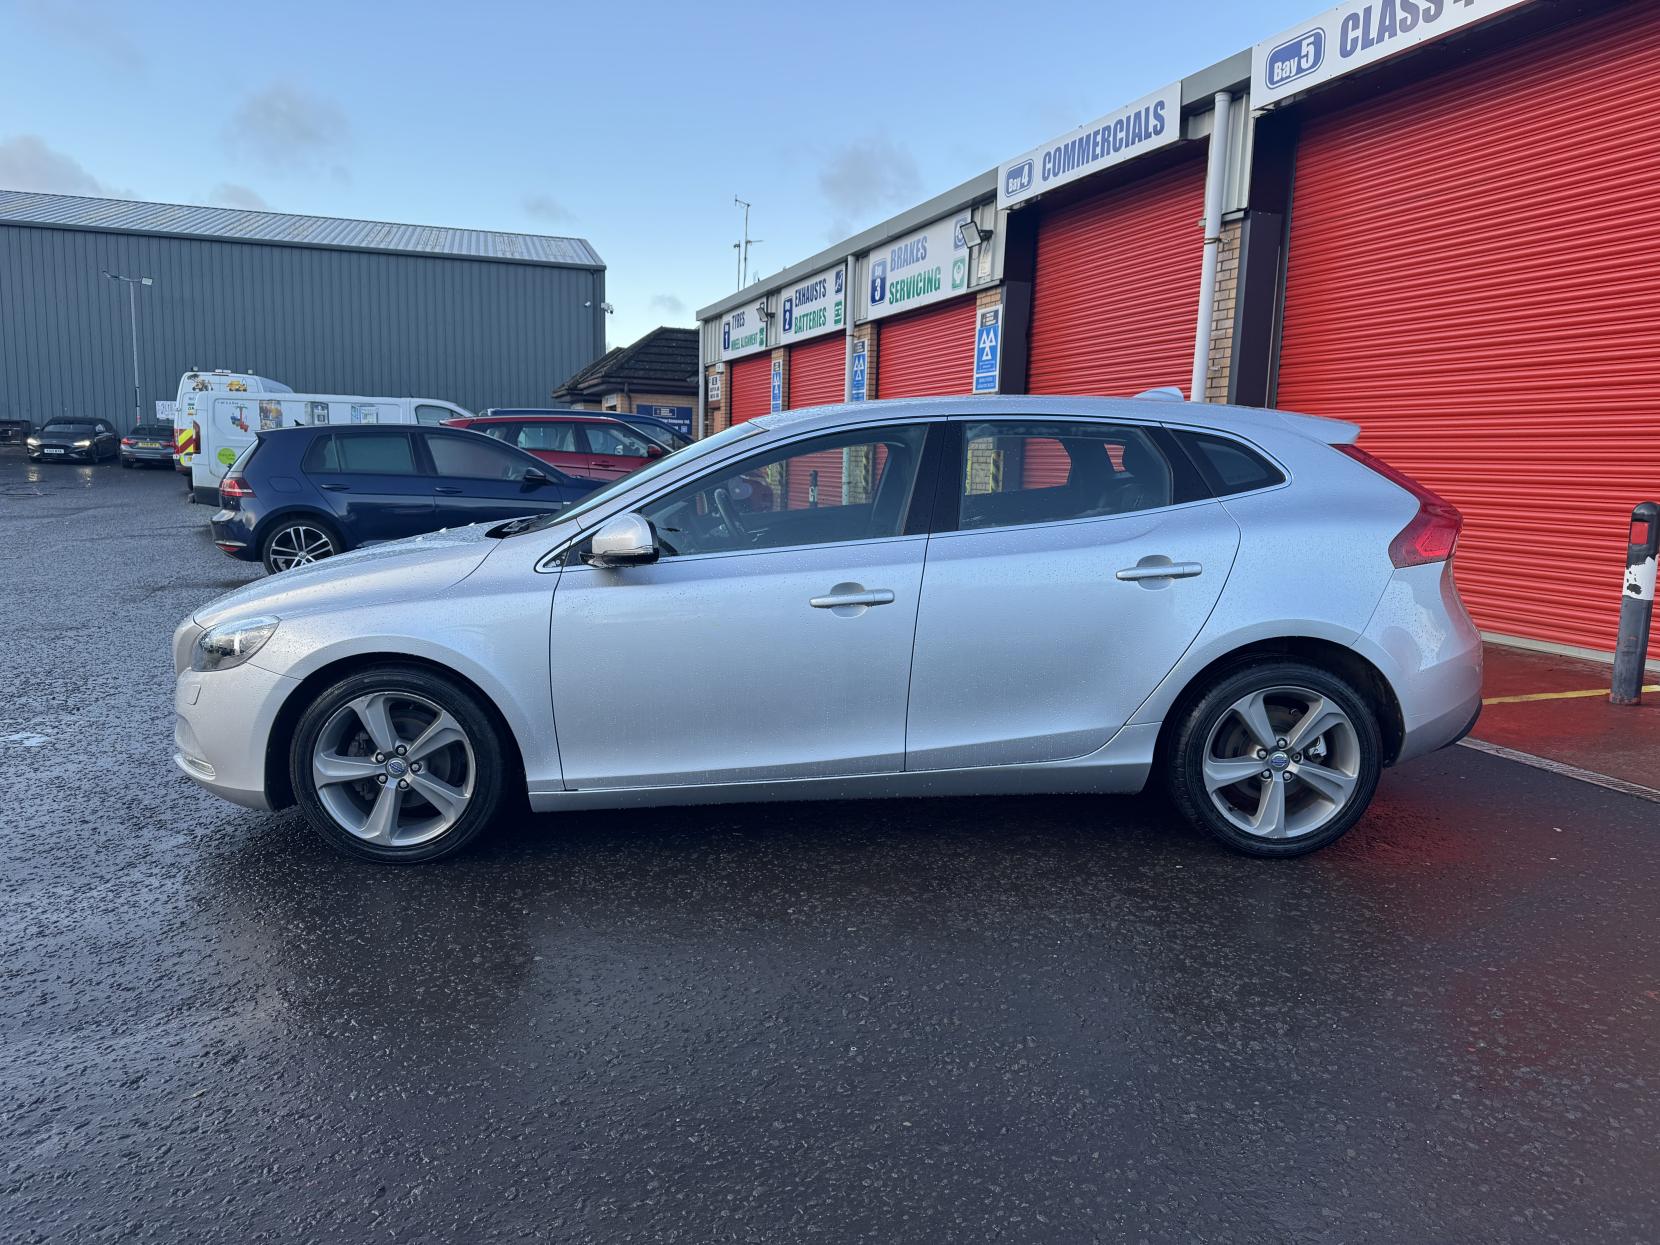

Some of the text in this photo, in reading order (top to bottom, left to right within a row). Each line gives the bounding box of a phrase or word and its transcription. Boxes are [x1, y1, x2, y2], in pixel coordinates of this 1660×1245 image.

[1273, 36, 1315, 82] Bay 5
[1041, 100, 1165, 182] COMMERCIALS
[1008, 164, 1029, 191] Bay 4
[890, 235, 928, 272] BRAKES
[795, 277, 827, 308] EXHAUSTS
[874, 278, 881, 301] 3
[889, 266, 941, 305] SERVICING
[732, 310, 745, 331] TYRES
[784, 311, 790, 330] 2
[795, 306, 827, 334] BATTERIES
